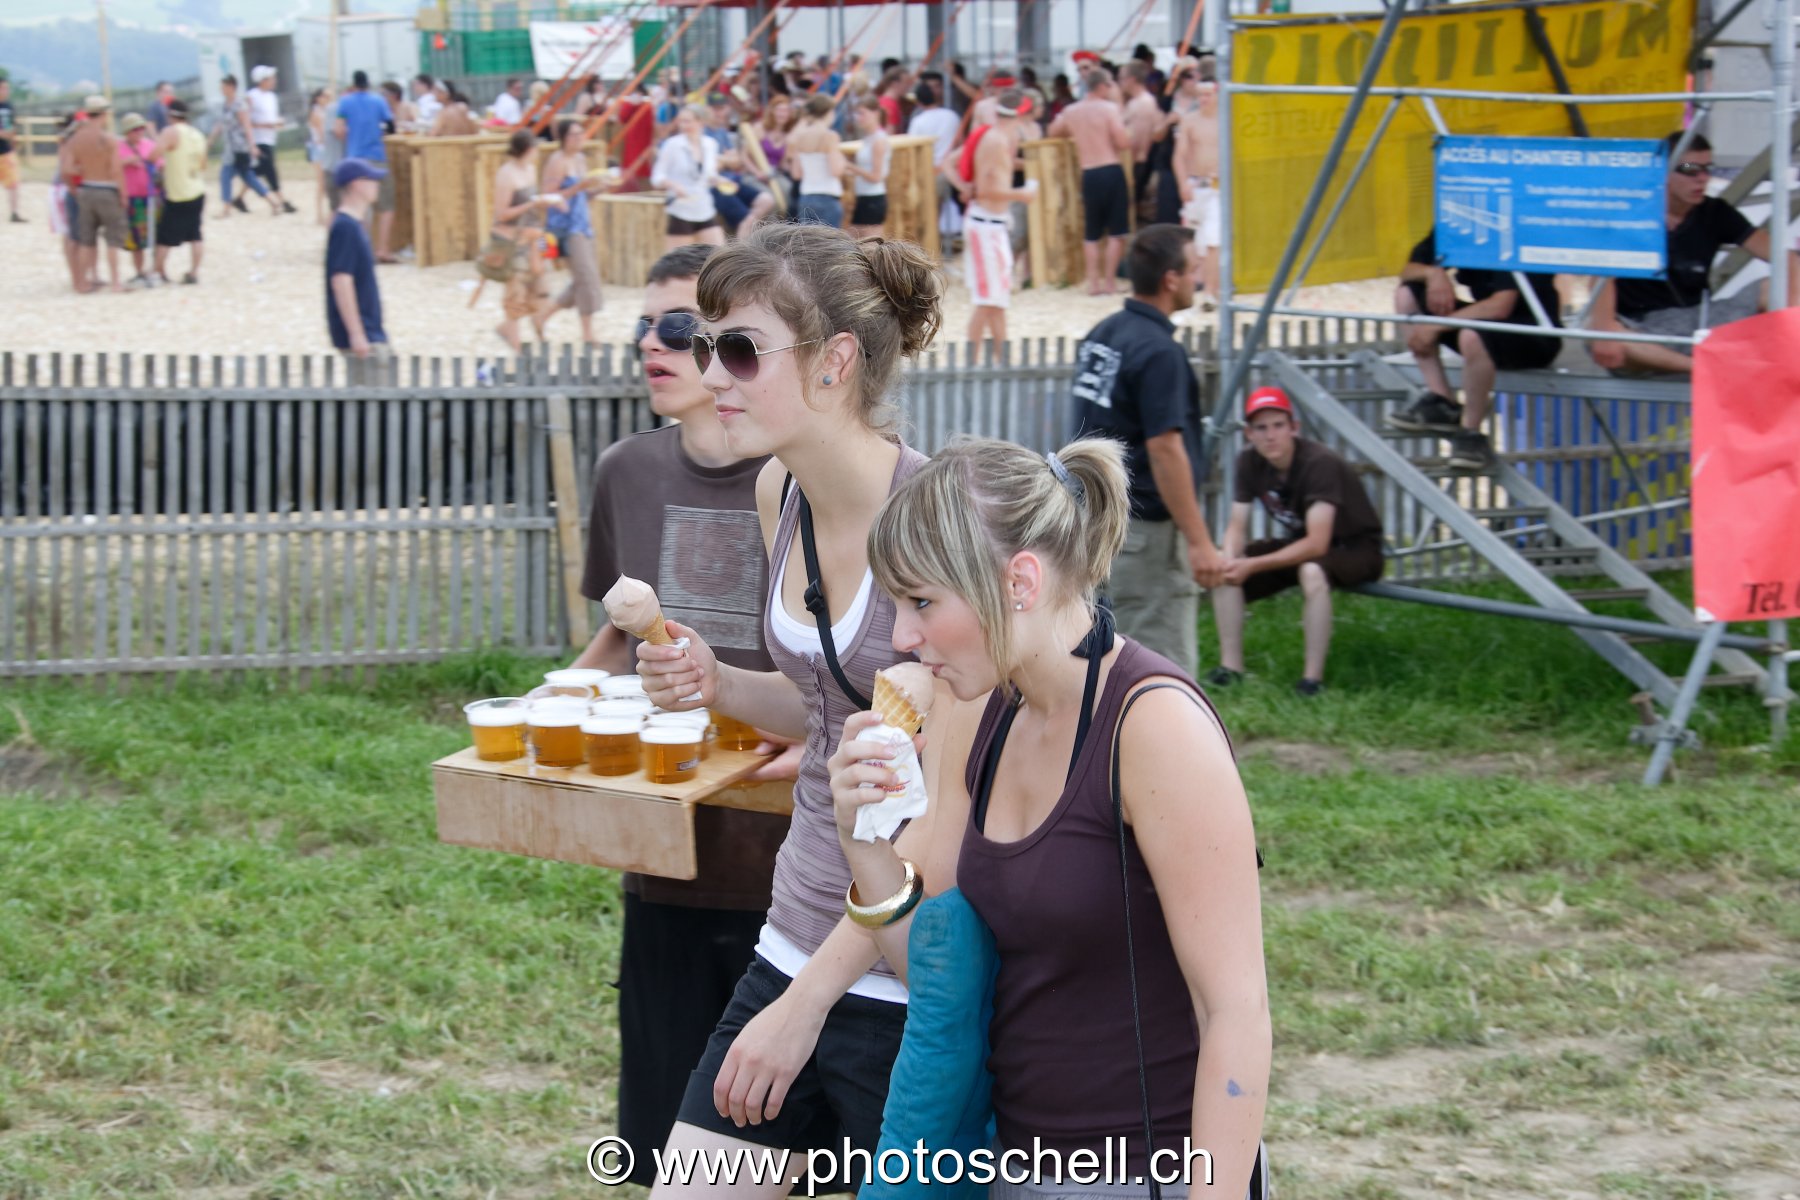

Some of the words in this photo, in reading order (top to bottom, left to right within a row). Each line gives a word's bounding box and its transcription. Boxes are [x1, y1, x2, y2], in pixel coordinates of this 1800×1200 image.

[1490, 149, 1509, 164] AU
[1512, 149, 1582, 166] CHANTIER
[1584, 150, 1653, 168] INTERDIT
